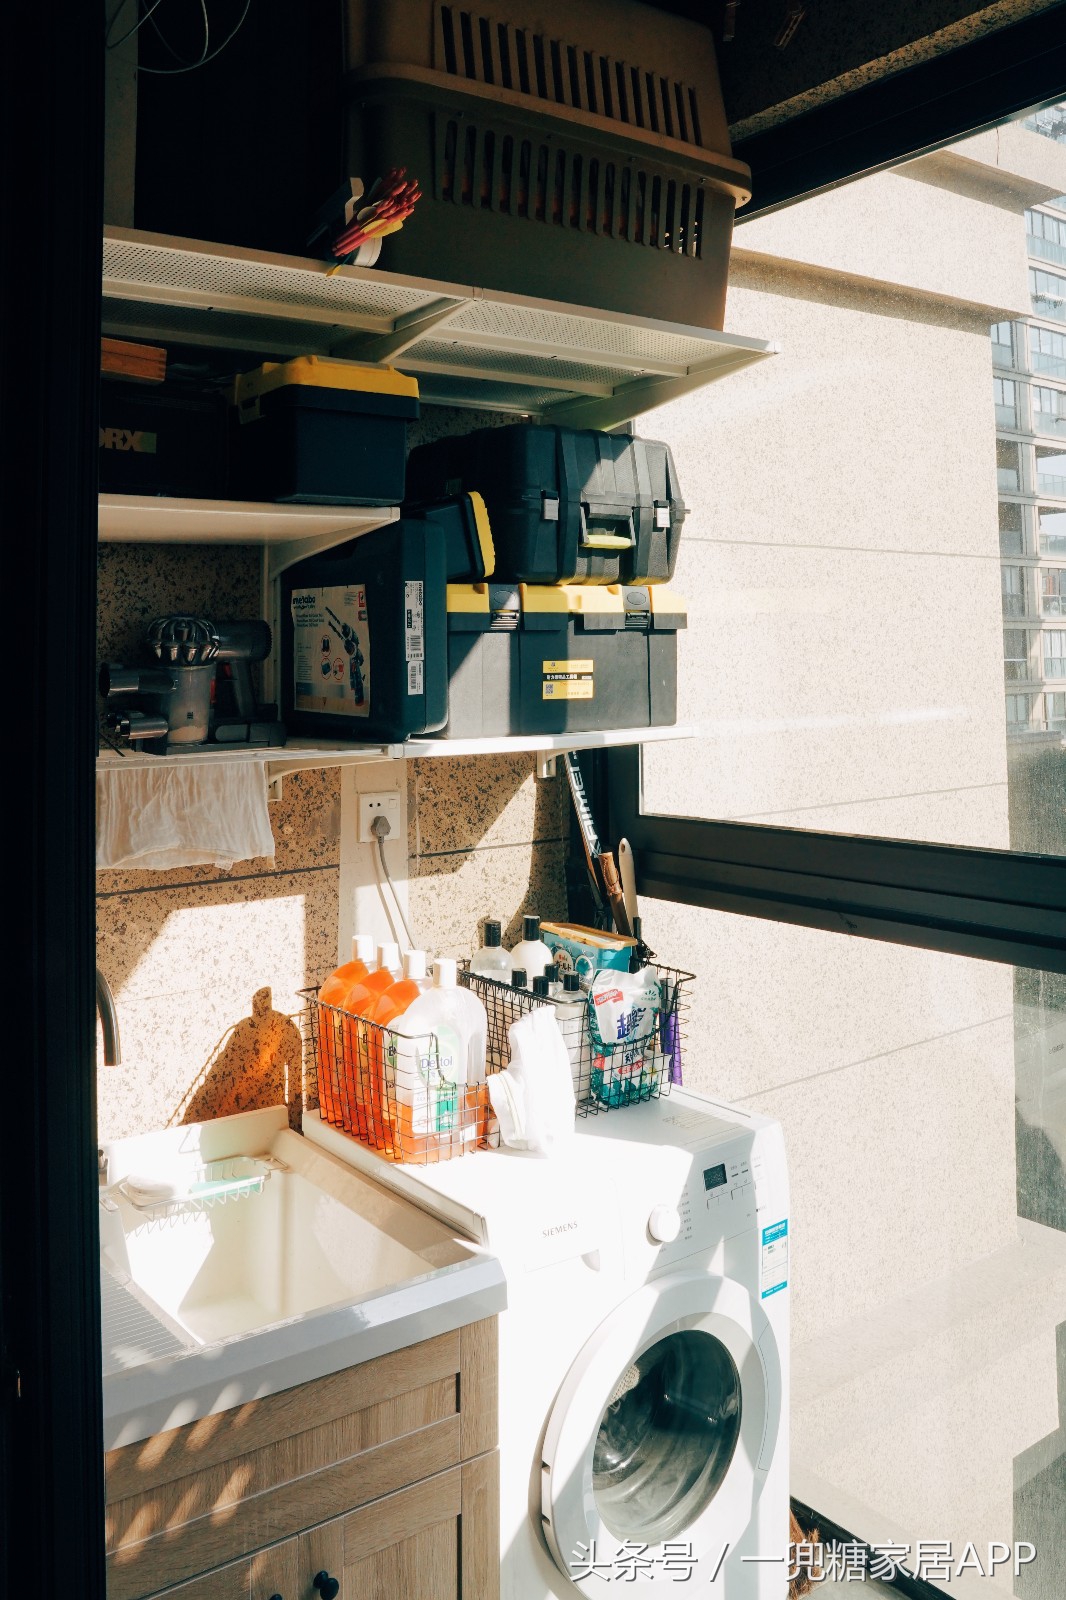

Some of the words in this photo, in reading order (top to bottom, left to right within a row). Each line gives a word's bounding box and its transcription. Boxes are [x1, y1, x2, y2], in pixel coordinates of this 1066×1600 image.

[292, 595, 316, 605] metabo
[421, 1056, 453, 1069] Detol
[542, 1221, 578, 1238] SIEMENS
